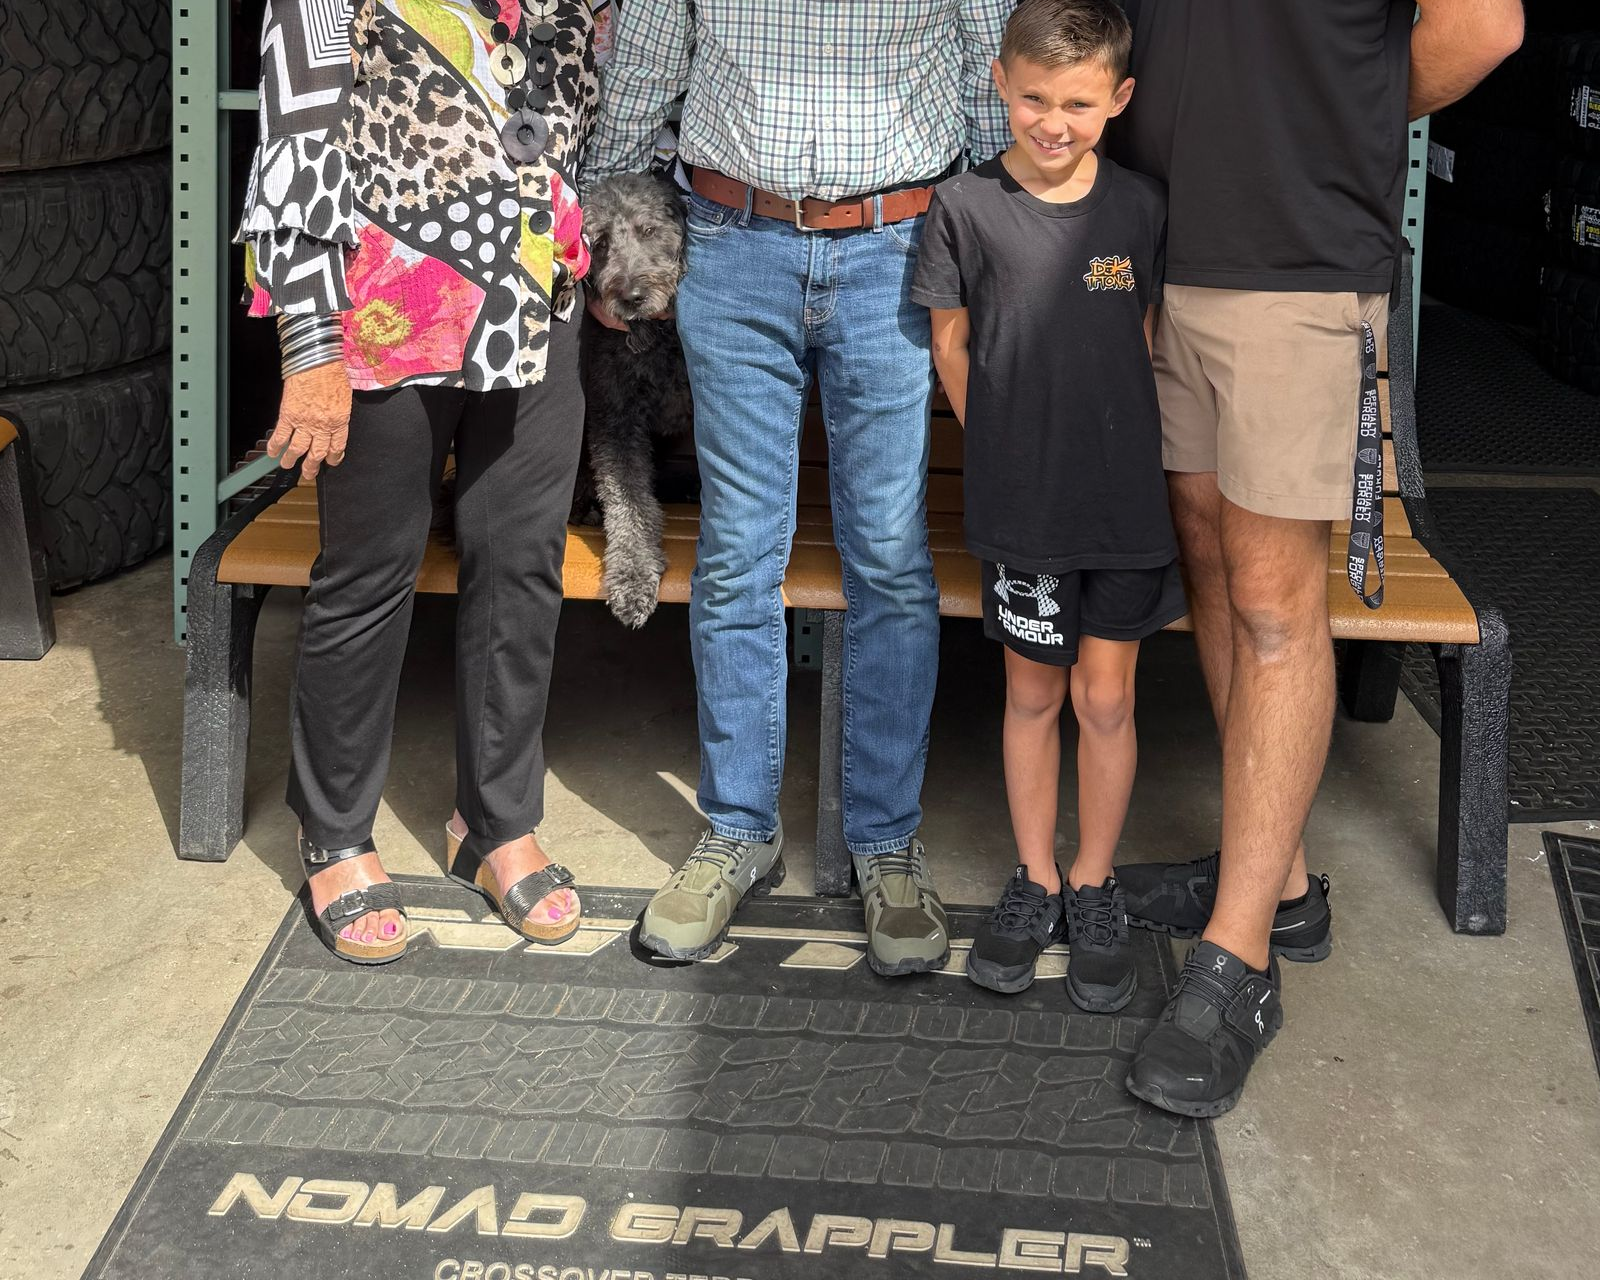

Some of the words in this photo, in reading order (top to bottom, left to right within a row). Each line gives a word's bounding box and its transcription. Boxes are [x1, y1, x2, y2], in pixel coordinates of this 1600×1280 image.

[1360, 390, 1372, 437] FORGED
[1368, 388, 1377, 439] SPECIALTY
[1355, 473, 1367, 521] FORGED
[1363, 473, 1374, 523] SPECIALTY
[998, 604, 1054, 634] UNDER
[998, 616, 1064, 646] RMOUR
[207, 1171, 588, 1239] NOMAD
[609, 1200, 1130, 1276] GRAPPLER
